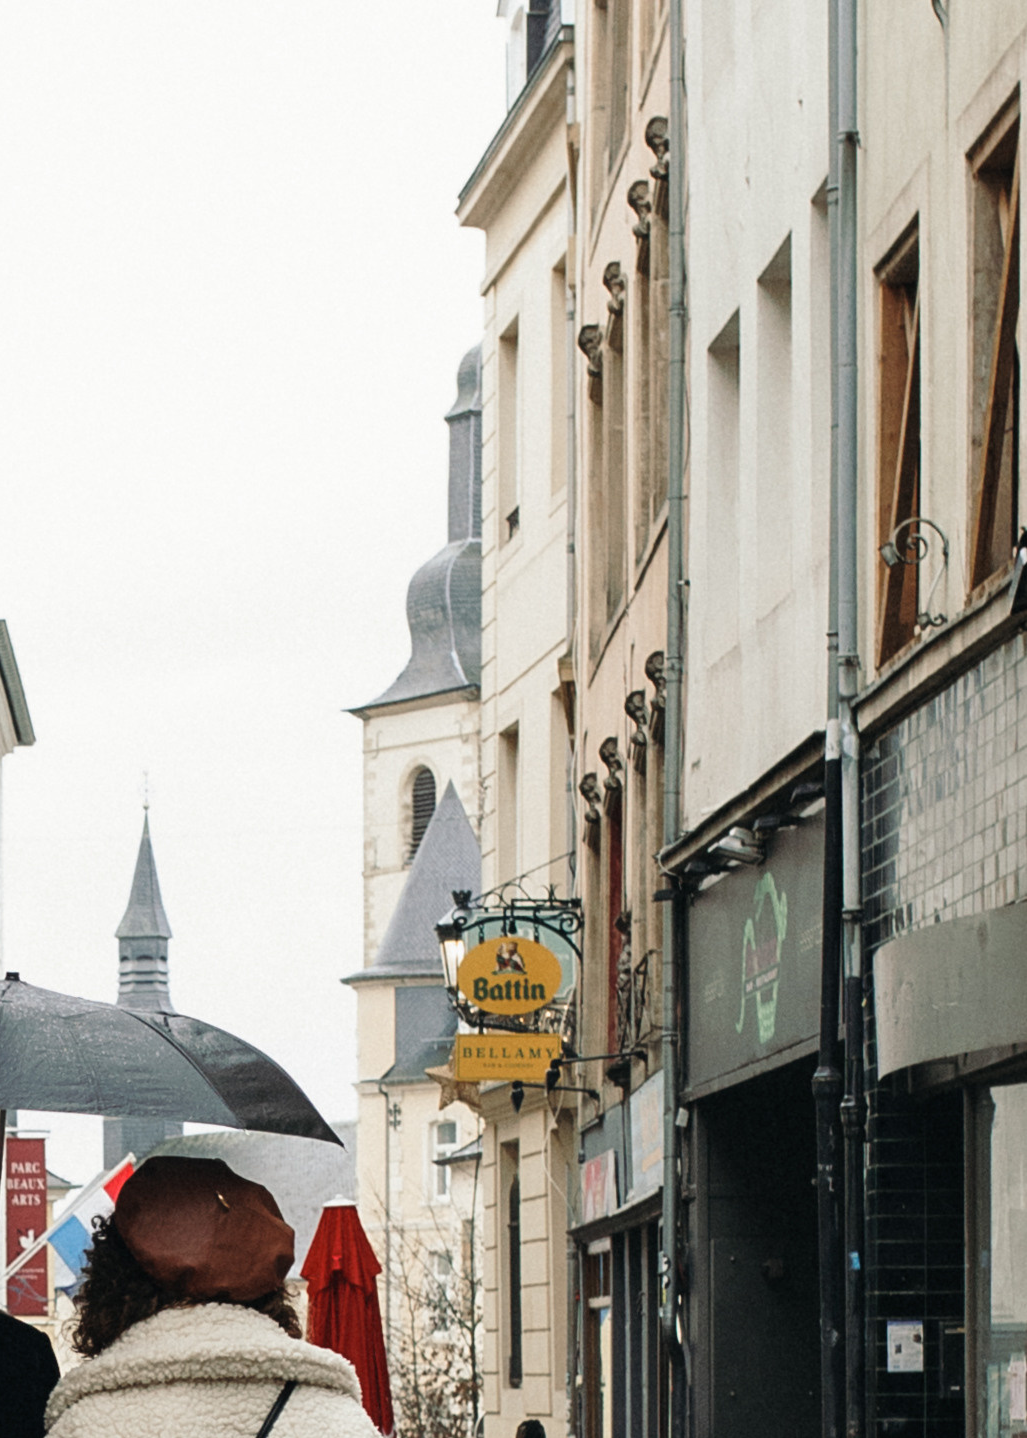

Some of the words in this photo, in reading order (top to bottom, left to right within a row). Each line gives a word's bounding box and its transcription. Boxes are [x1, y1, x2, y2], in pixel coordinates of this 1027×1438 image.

[473, 977, 545, 1001] Battin
[463, 1047, 554, 1058] BELLAMY
[11, 1162, 41, 1174] PARC
[7, 1178, 45, 1190] BEAUX
[12, 1194, 41, 1206] ARTS
